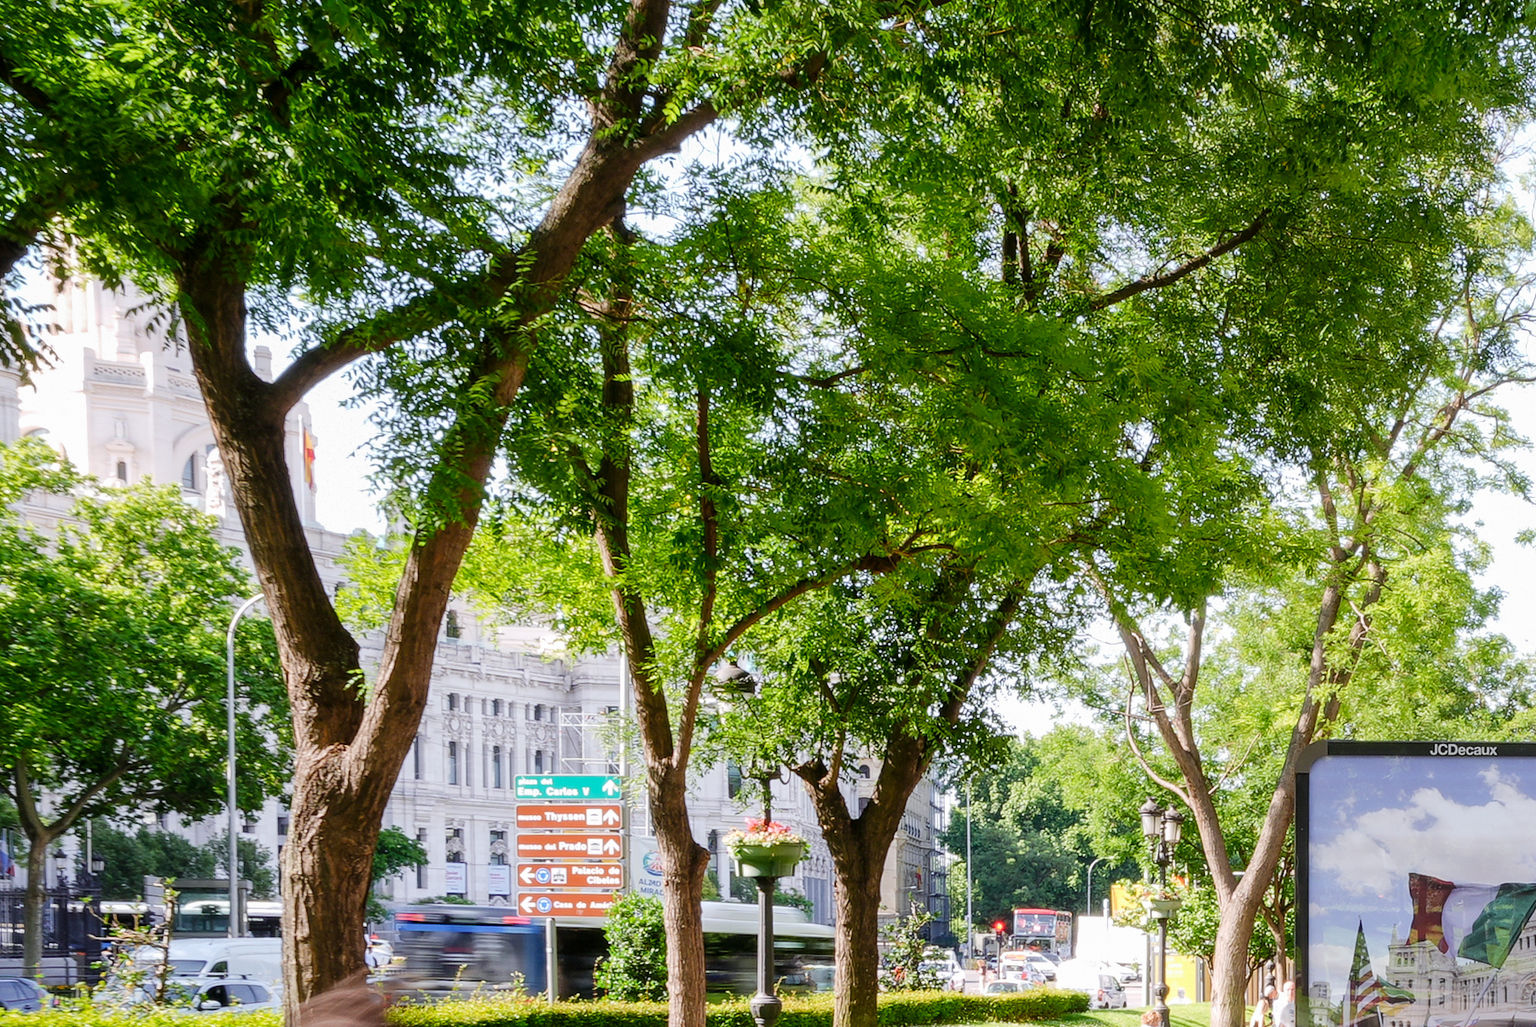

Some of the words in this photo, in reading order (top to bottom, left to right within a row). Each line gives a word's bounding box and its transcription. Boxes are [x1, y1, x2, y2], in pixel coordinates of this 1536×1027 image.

[1430, 744, 1498, 756] JCDecaux
[518, 778, 538, 786] plaza
[540, 778, 553, 786] del
[517, 787, 543, 797] Emp.
[546, 786, 579, 796] Carlos
[582, 787, 590, 796] V
[544, 811, 585, 822] Thyssen
[558, 841, 587, 851] Prado
[571, 866, 605, 875] Palacio
[608, 866, 620, 875] de
[586, 876, 620, 885] Cibeles
[553, 901, 573, 909] Casa
[576, 901, 587, 909] de
